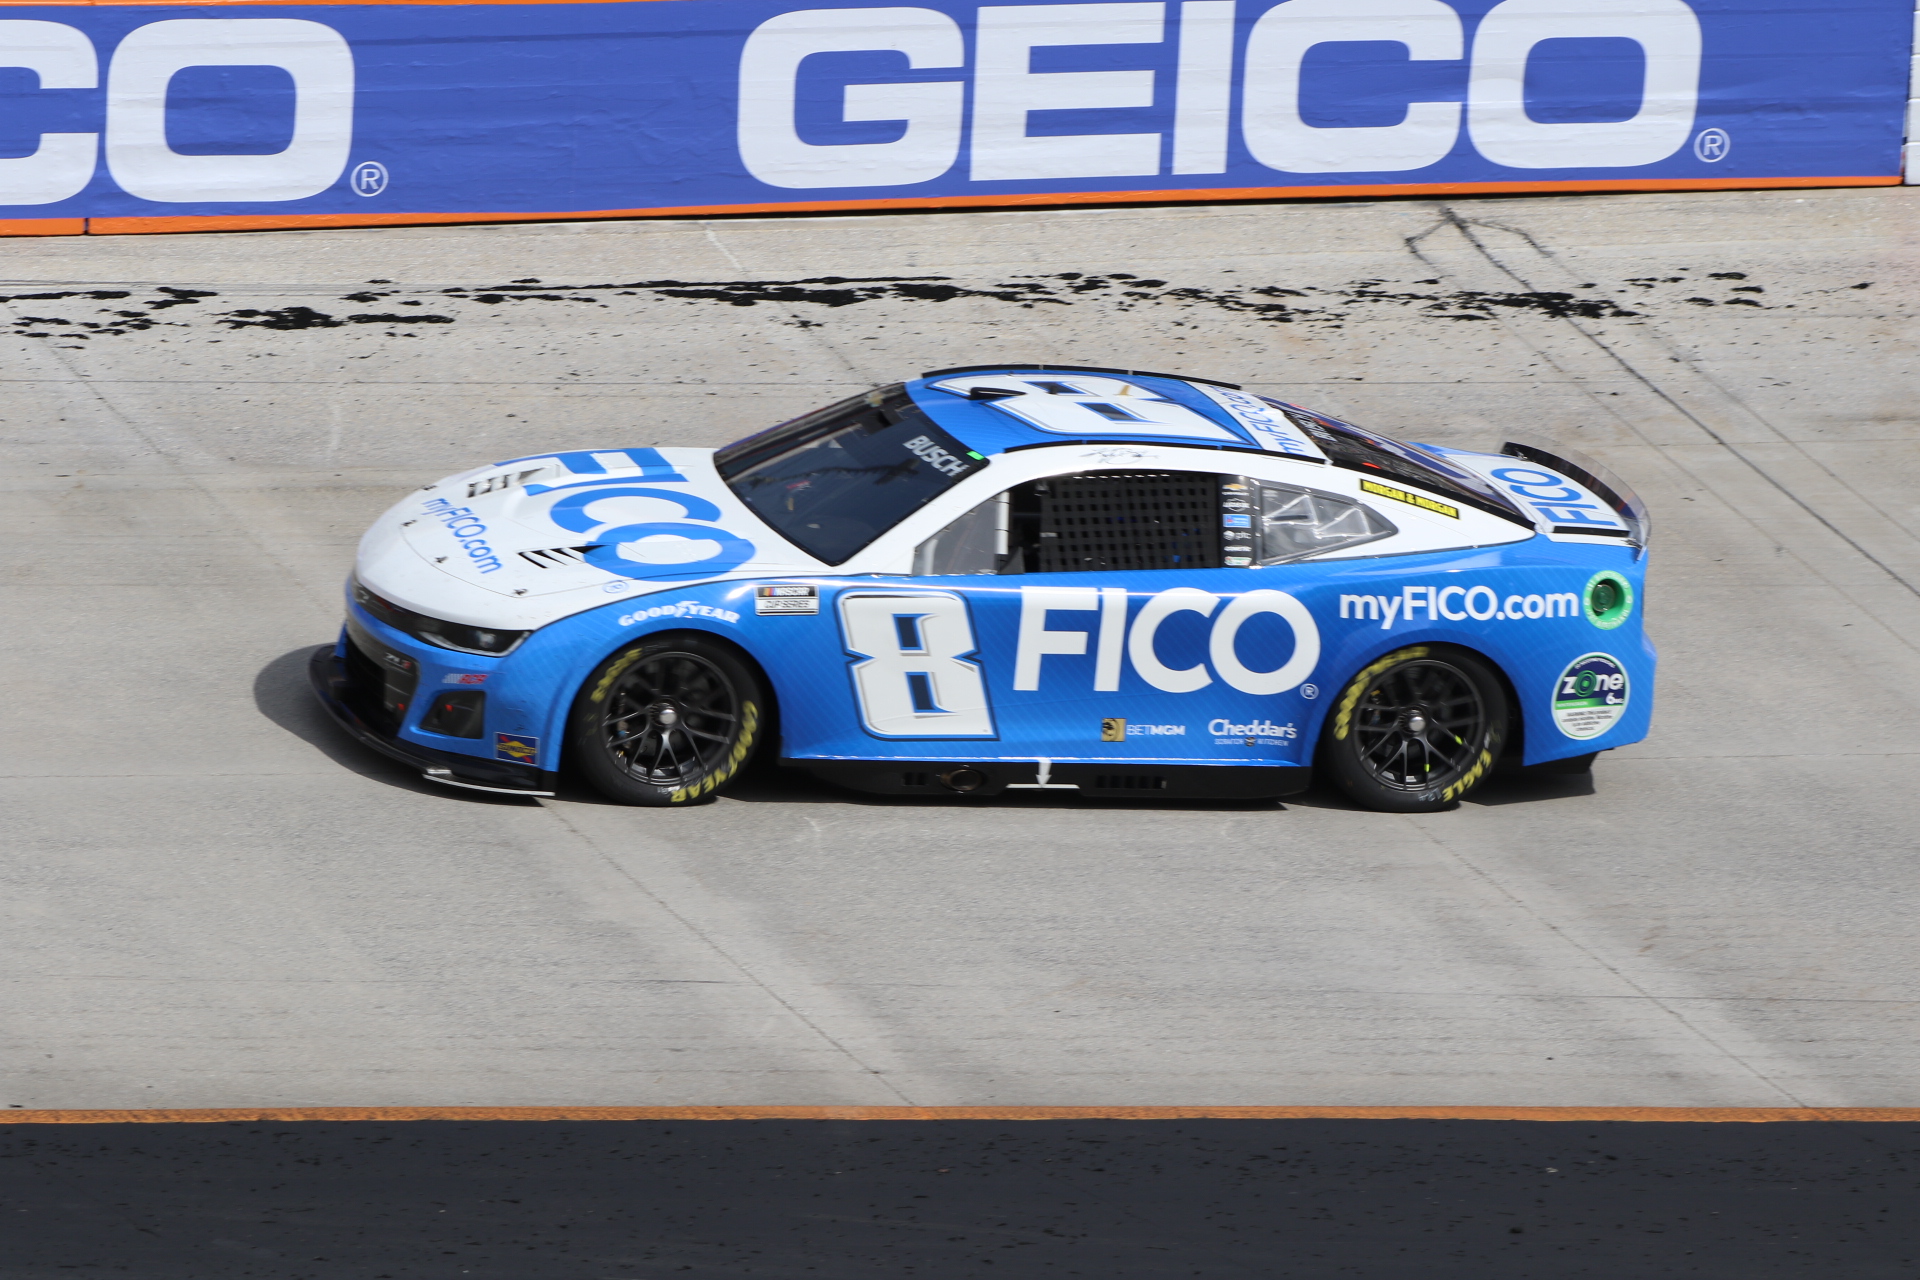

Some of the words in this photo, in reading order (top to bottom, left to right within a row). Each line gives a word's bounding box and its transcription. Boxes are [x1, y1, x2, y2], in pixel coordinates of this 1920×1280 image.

[737, 0, 1703, 190] GEICO
[903, 435, 971, 476] BUSCH
[493, 447, 756, 582] FICO
[1362, 480, 1405, 502] MORGAN
[1405, 492, 1415, 505] &
[1415, 495, 1457, 518] MORGAN
[1491, 468, 1620, 526] FICO
[422, 498, 503, 574] myFICO.com
[618, 601, 741, 626] GOODYEAR
[773, 586, 811, 597] NASCAR
[1339, 585, 1579, 629] myFICO.com
[835, 588, 999, 740] 8
[1013, 586, 1321, 695] FICO
[670, 700, 759, 802] GOODYEAR
[1126, 724, 1186, 736] BETMGM
[1208, 718, 1297, 739] Cheddar's
[1442, 748, 1492, 802] EAGLE
